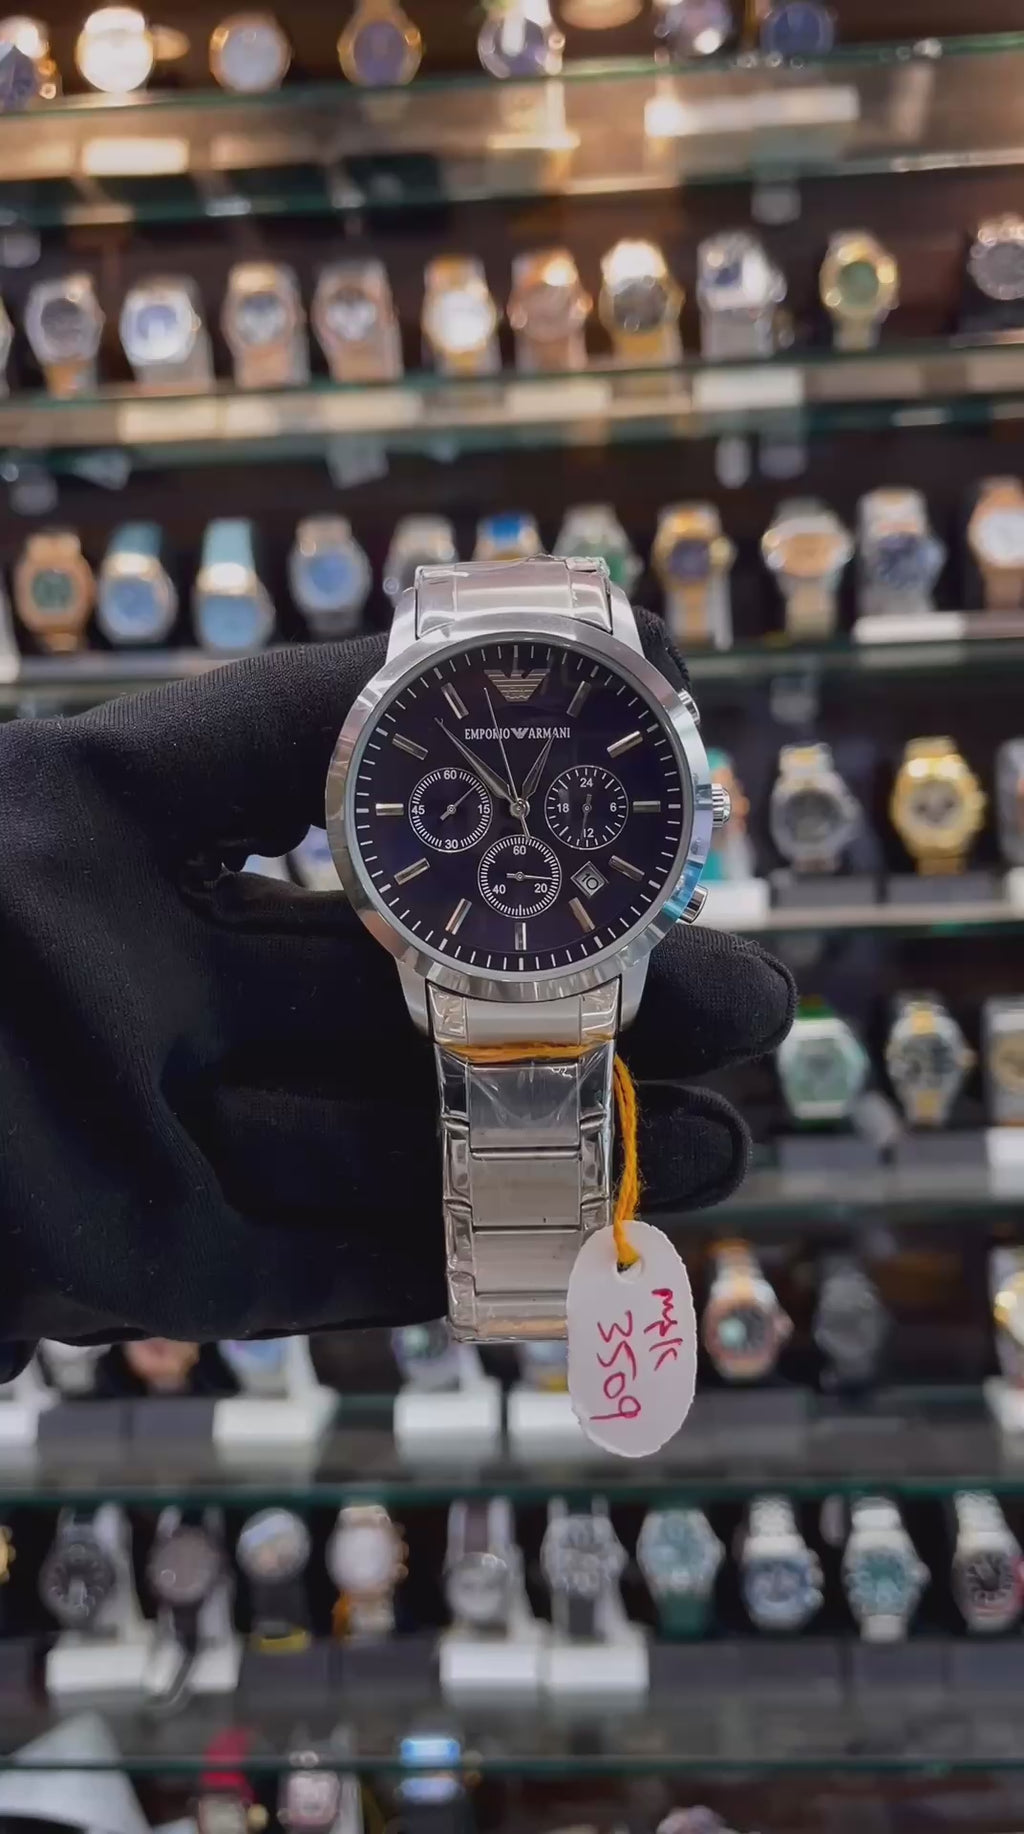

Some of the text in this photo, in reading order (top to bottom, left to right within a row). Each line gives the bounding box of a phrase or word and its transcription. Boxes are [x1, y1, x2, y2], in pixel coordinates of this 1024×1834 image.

[464, 727, 571, 740] EMPORIO ARMANI
[444, 770, 457, 780] 60
[580, 778, 593, 788] 24
[412, 805, 425, 814] 45
[478, 805, 490, 814] 15
[557, 804, 569, 813] 18
[610, 803, 617, 812] 6
[582, 829, 594, 838] 12
[445, 839, 458, 849] 30
[513, 845, 526, 855] 60
[582, 873, 599, 890] 10
[492, 885, 506, 894] 40
[534, 884, 547, 893] 20
[590, 1310, 641, 1421] 3509
